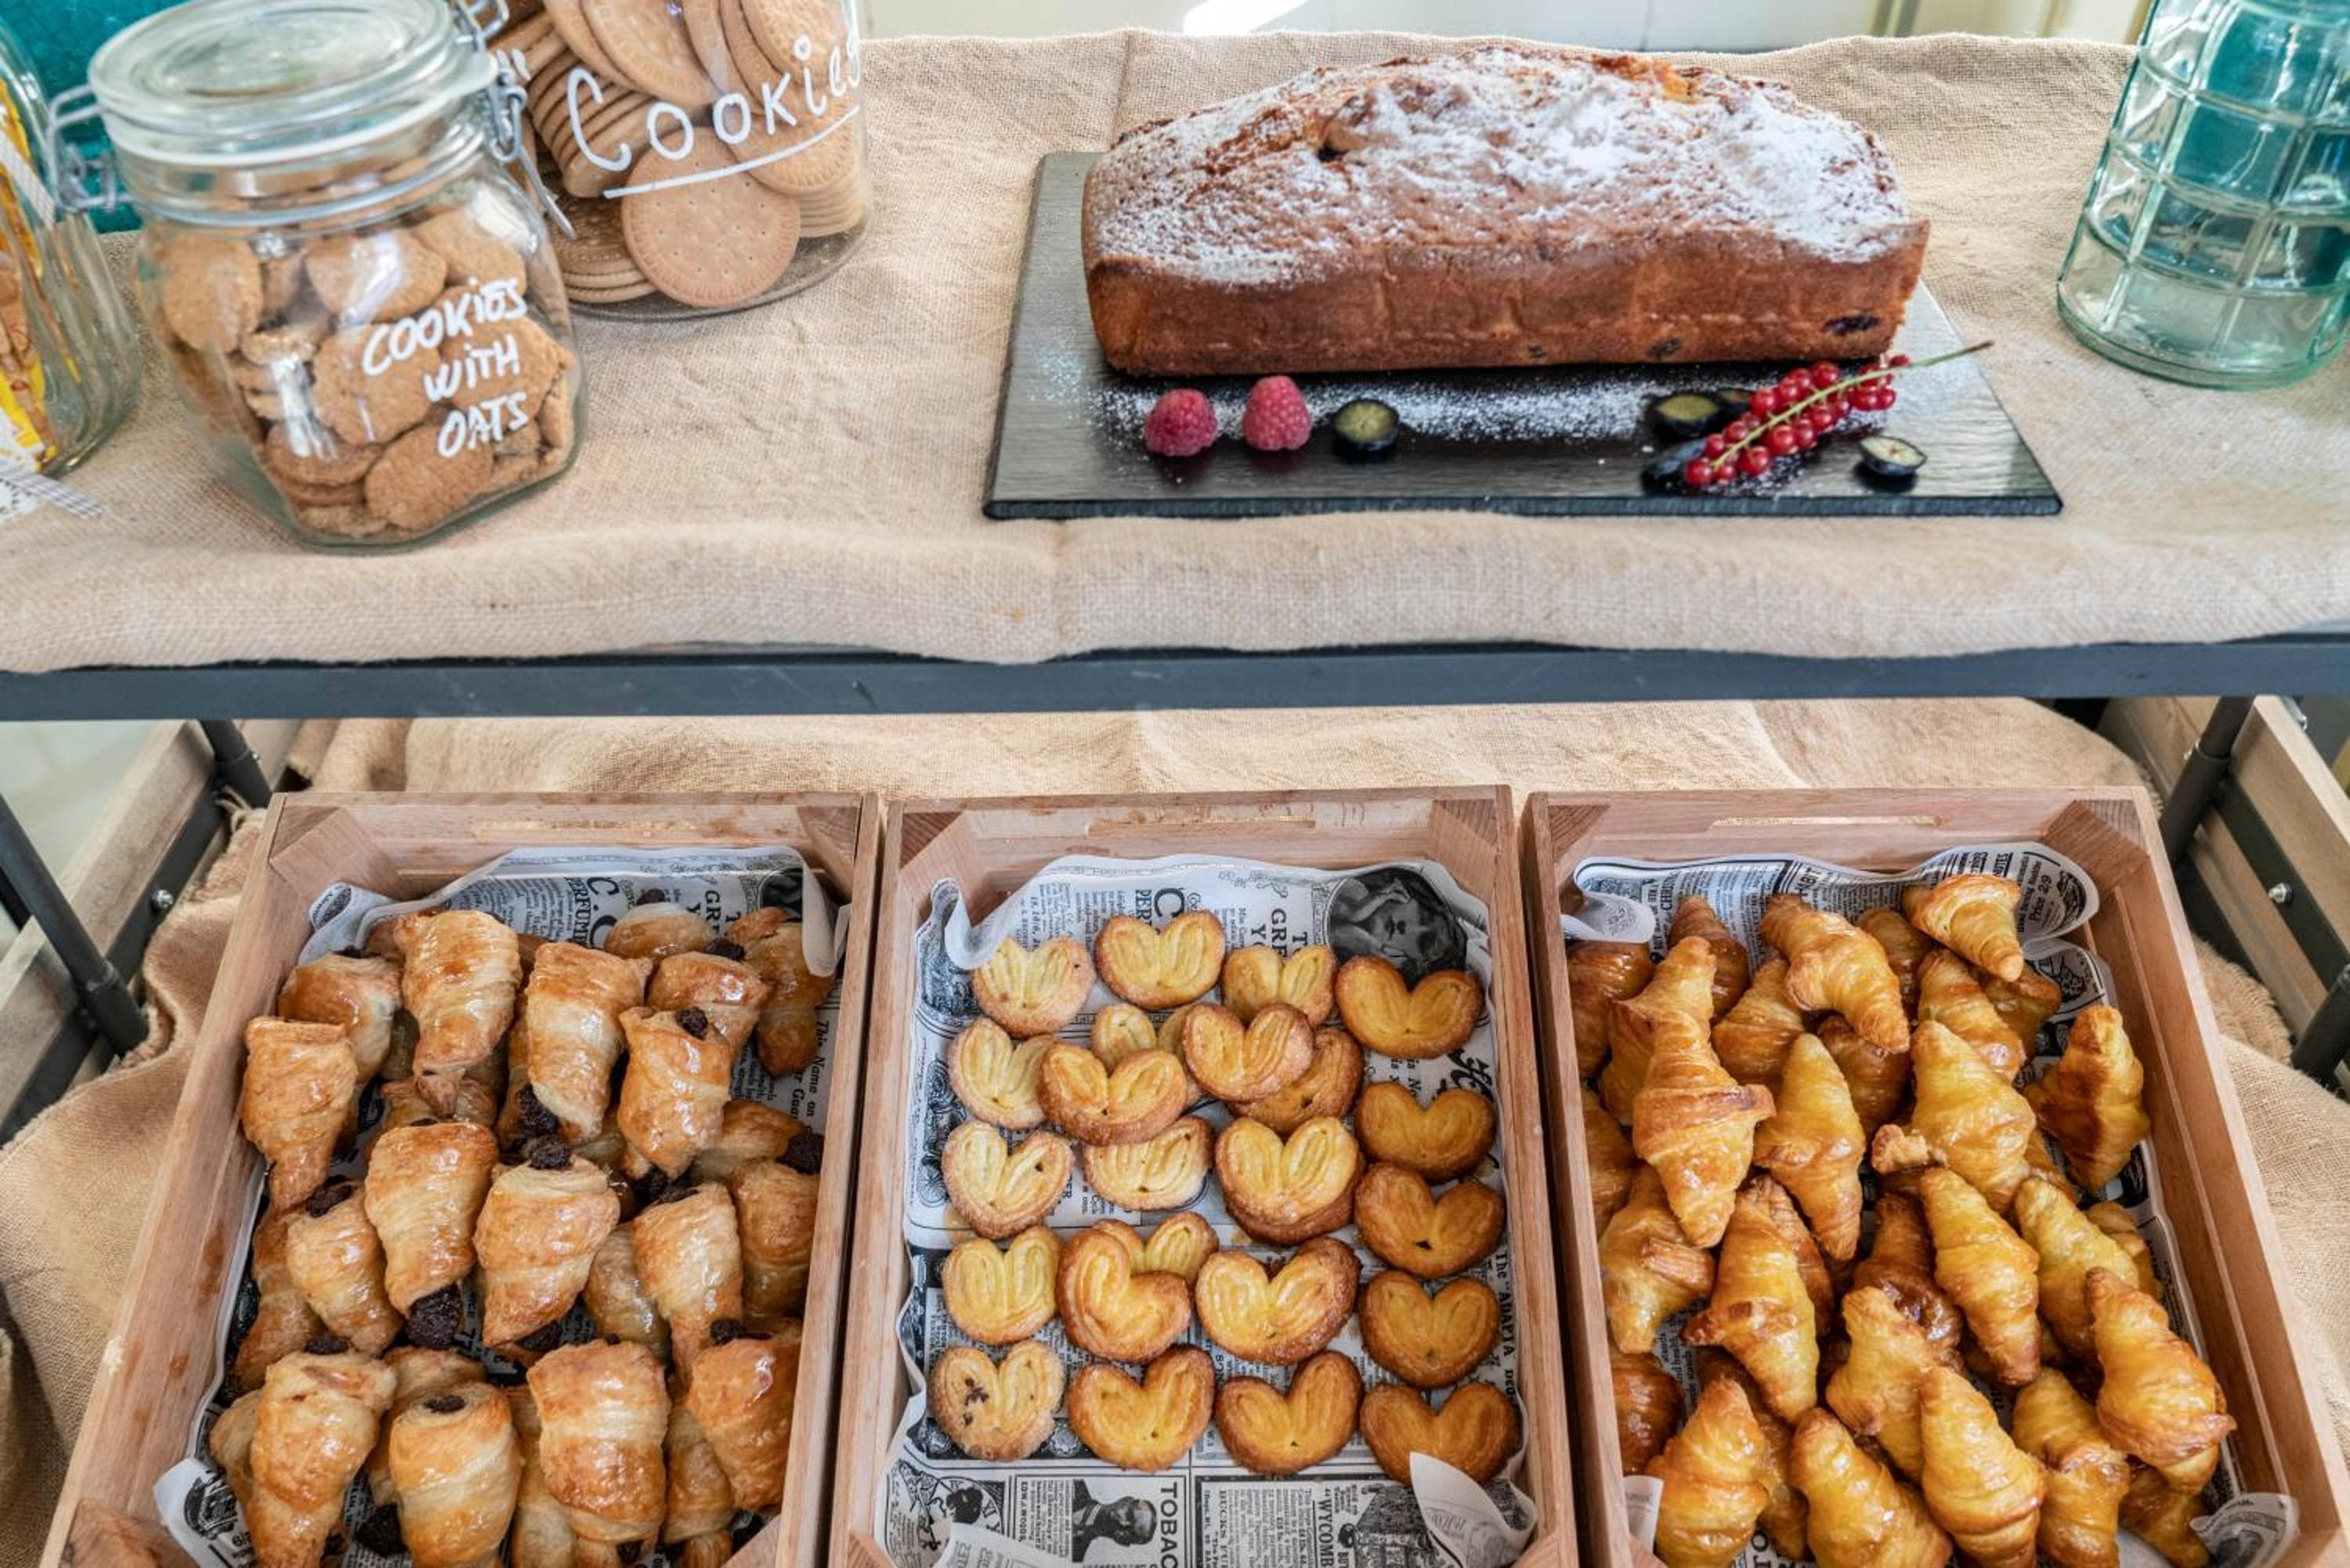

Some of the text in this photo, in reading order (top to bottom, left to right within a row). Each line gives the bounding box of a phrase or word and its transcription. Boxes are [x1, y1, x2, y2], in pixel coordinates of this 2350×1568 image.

[437, 392, 529, 460] OATS
[2028, 897, 2045, 922] Price
[807, 1020, 829, 1117] This Name on
[1495, 1253, 1508, 1279] The
